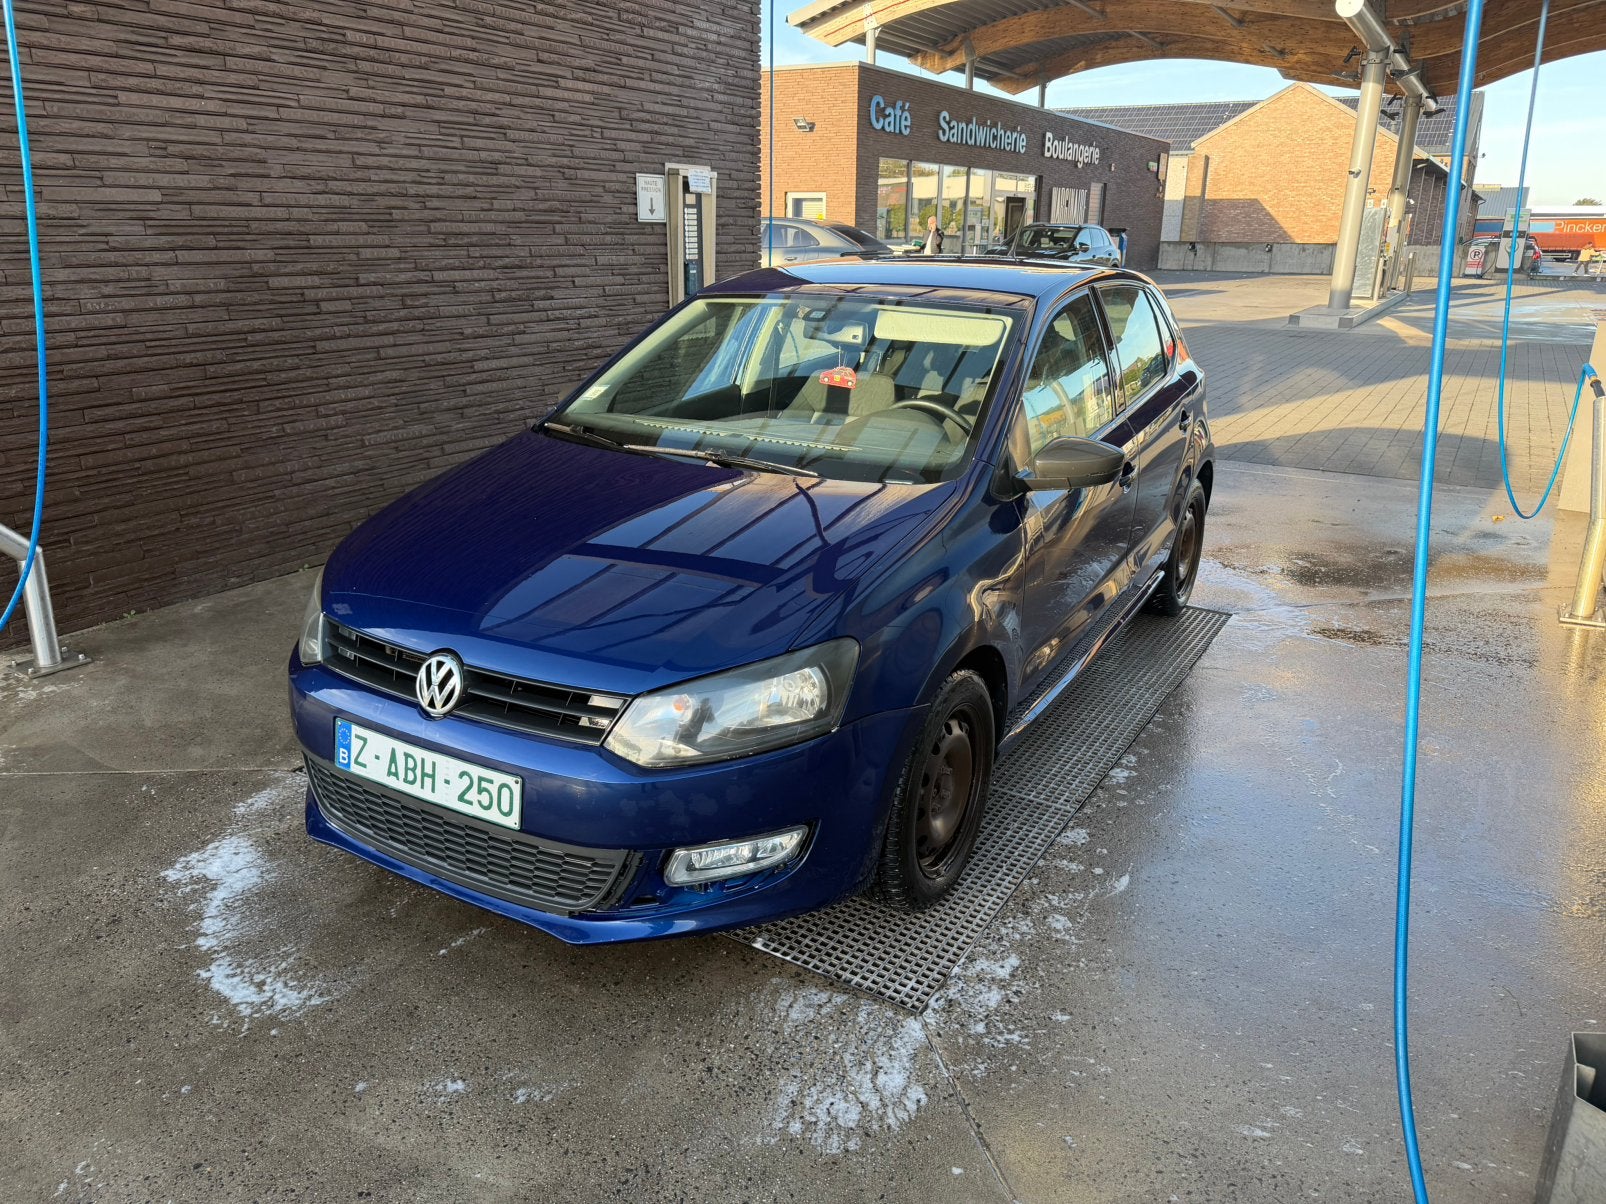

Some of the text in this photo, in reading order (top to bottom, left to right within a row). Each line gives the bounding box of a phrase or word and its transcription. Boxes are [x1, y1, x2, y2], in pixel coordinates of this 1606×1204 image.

[870, 95, 1100, 169] Café Sandwicherie Boulangerie
[339, 747, 349, 765] B
